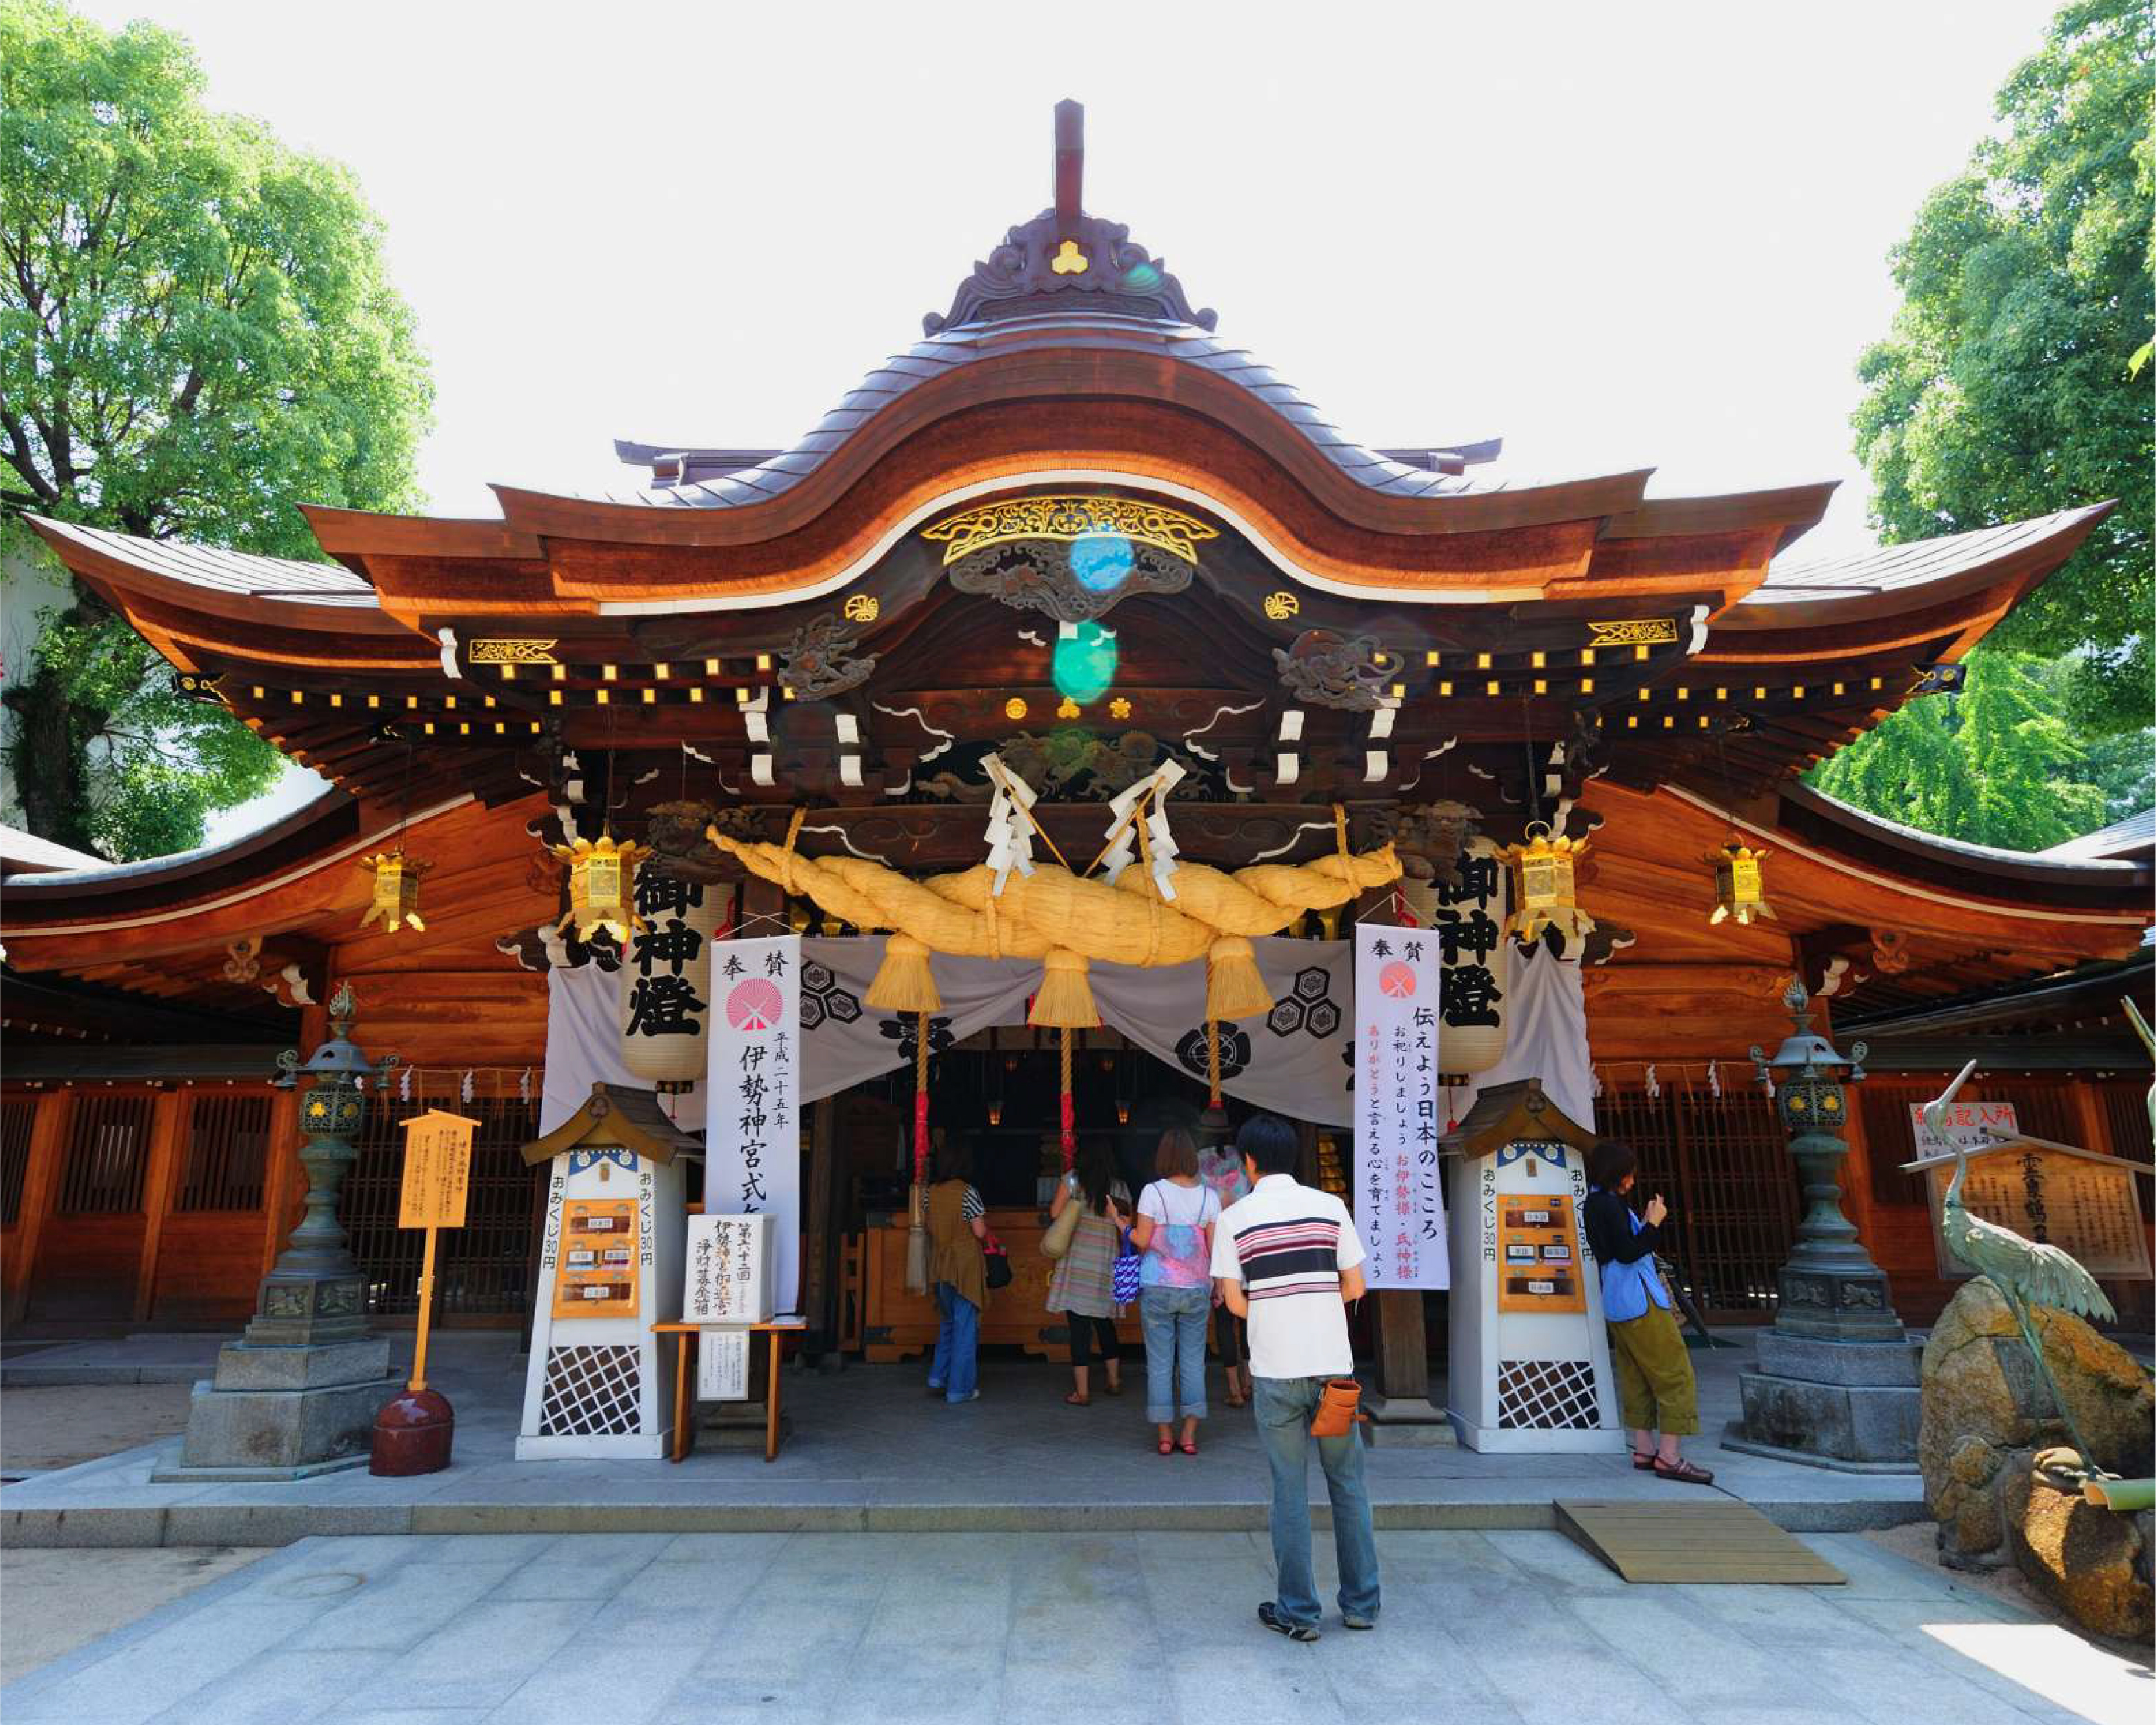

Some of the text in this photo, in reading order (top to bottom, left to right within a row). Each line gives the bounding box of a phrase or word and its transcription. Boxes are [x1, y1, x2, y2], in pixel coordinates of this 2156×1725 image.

[722, 950, 788, 981] 奉賛
[1371, 939, 1424, 962] 奉賛
[772, 1031, 790, 1130] 平成二十五年
[1413, 1006, 1438, 1241] 伝えよう日本のこころ
[1367, 1024, 1384, 1279] ありがとうと言える心を育てましょう
[543, 1176, 564, 1268] おみくじ30円
[639, 1173, 653, 1266] おみくじ30円
